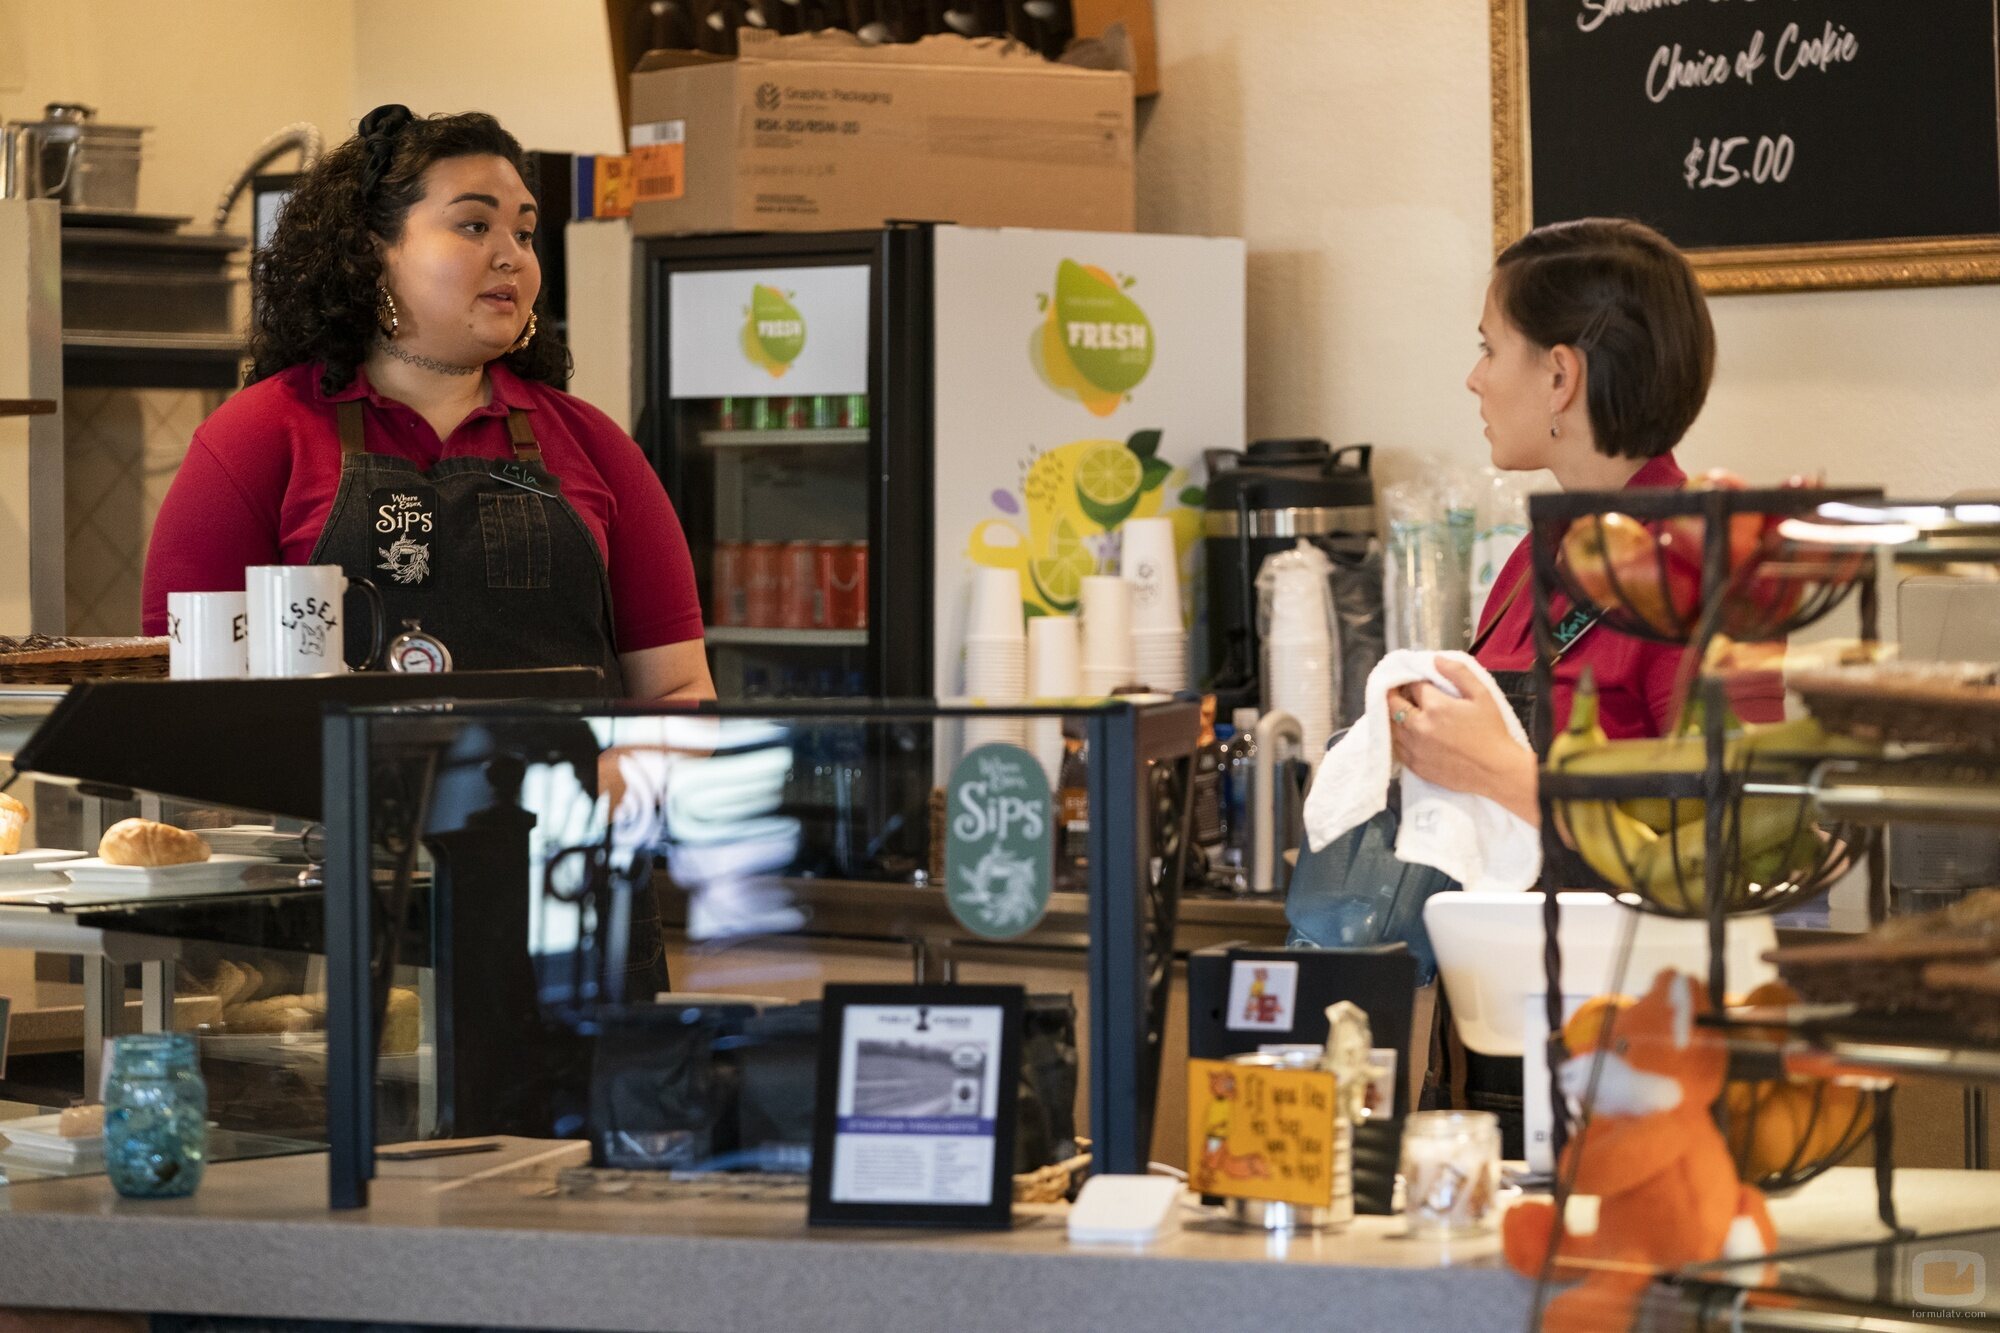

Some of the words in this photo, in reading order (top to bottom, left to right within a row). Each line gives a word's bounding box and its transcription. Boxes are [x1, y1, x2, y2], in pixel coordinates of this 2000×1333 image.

[1646, 43, 1731, 103] Choice
[1735, 30, 1766, 85] of
[1774, 20, 1859, 81] Cookie
[1683, 134, 1795, 189] $15.00
[1067, 321, 1147, 349] FRESH
[502, 464, 541, 487] Lila
[391, 493, 418, 503] Where
[399, 500, 423, 510] Essex
[375, 504, 433, 533] Sips
[281, 597, 338, 631] ESSEX
[953, 781, 1044, 842] Sips
